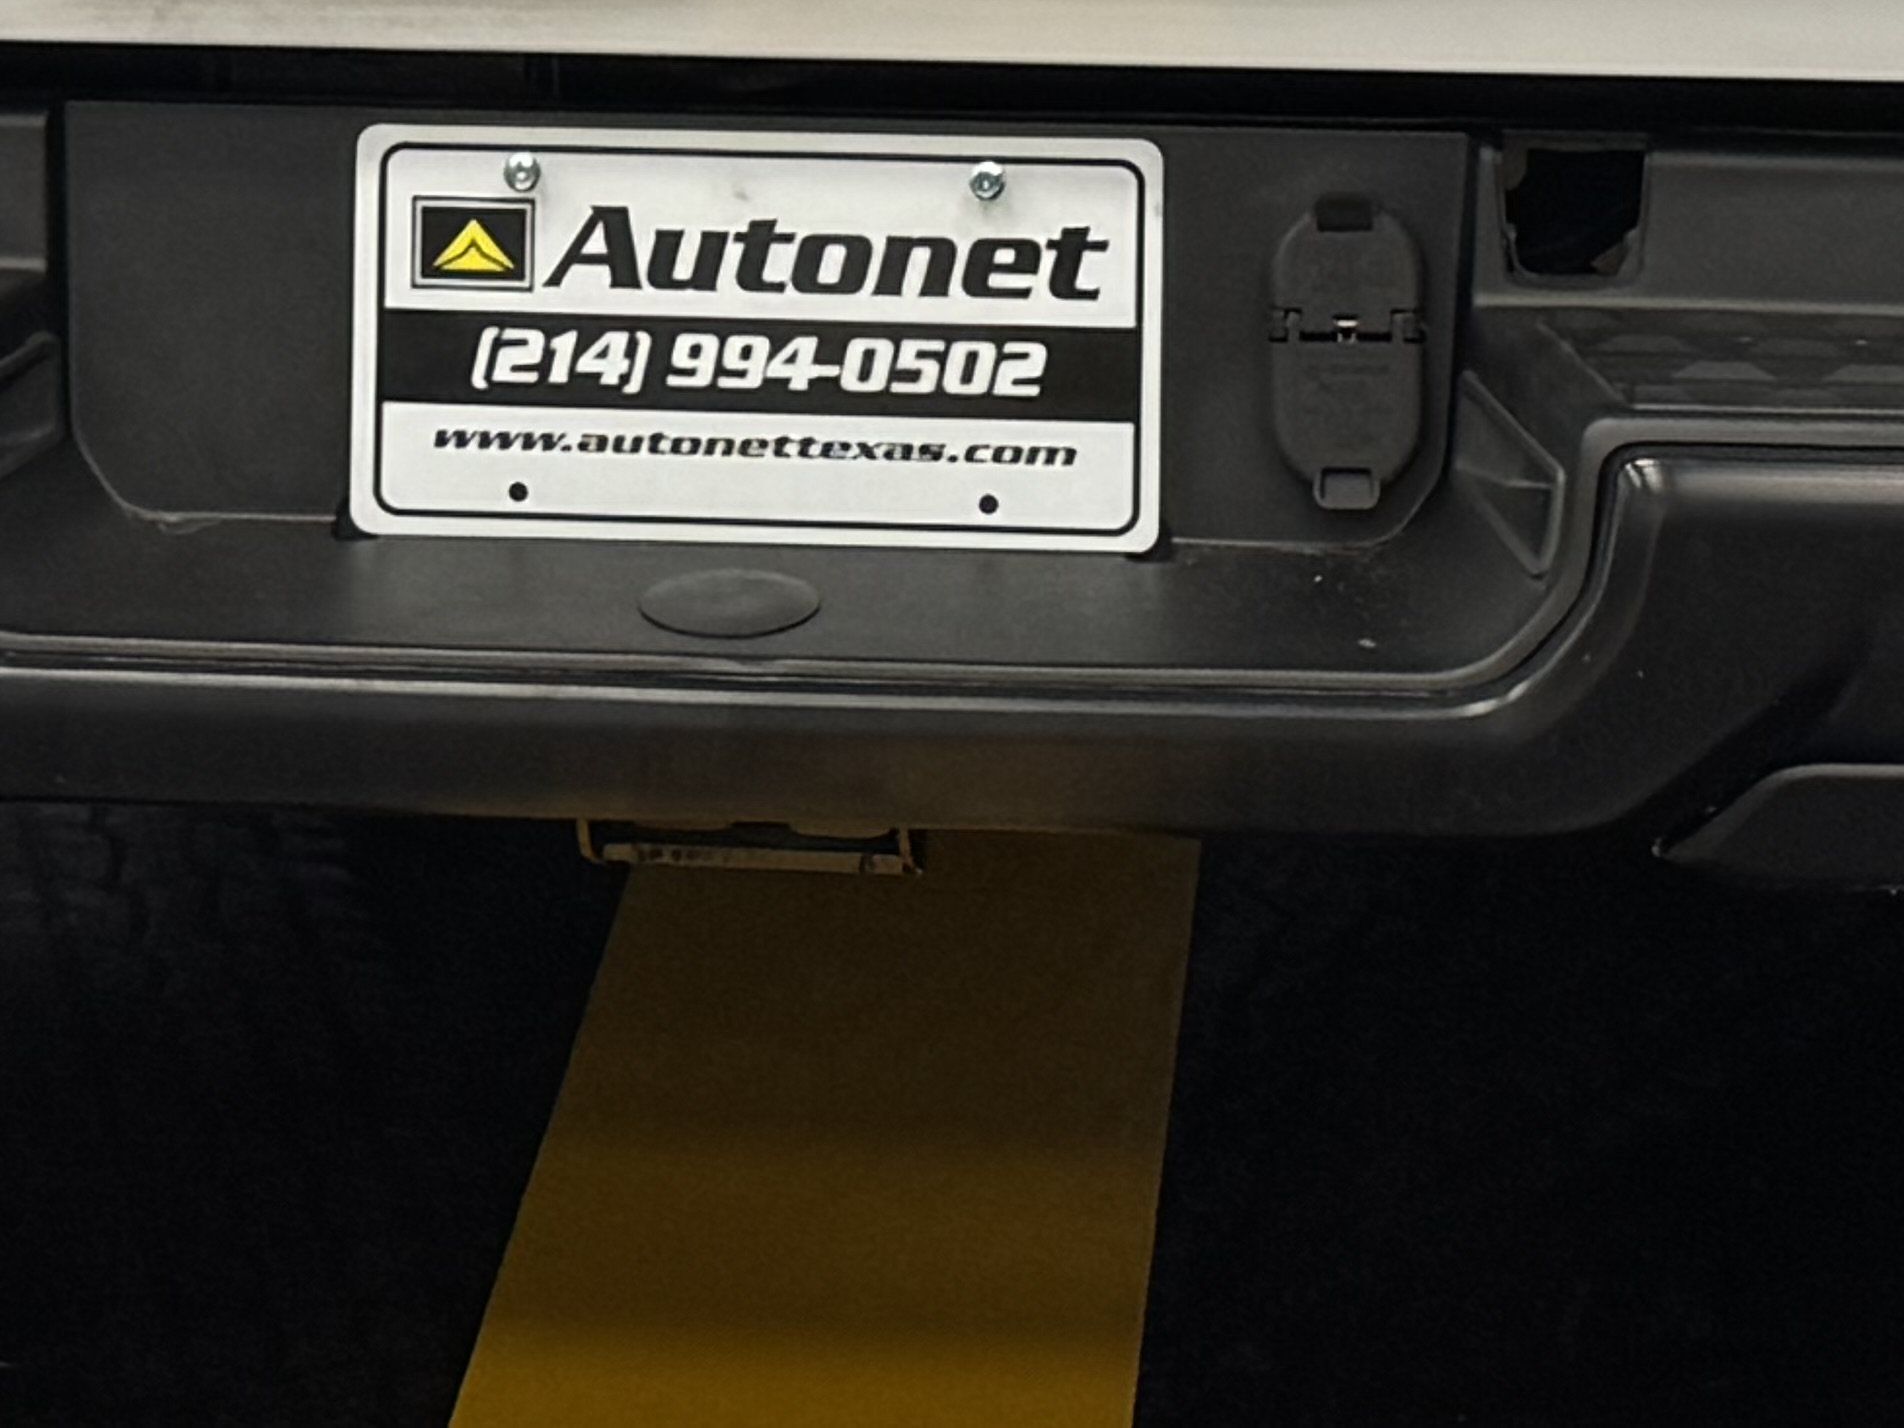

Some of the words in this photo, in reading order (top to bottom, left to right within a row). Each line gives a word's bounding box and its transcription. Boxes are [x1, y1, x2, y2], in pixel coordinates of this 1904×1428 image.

[543, 204, 1109, 301] Autonet
[471, 326, 652, 393] (214)
[665, 331, 1048, 398] 994-0502
[433, 426, 1077, 467] www.autonettexas.com
